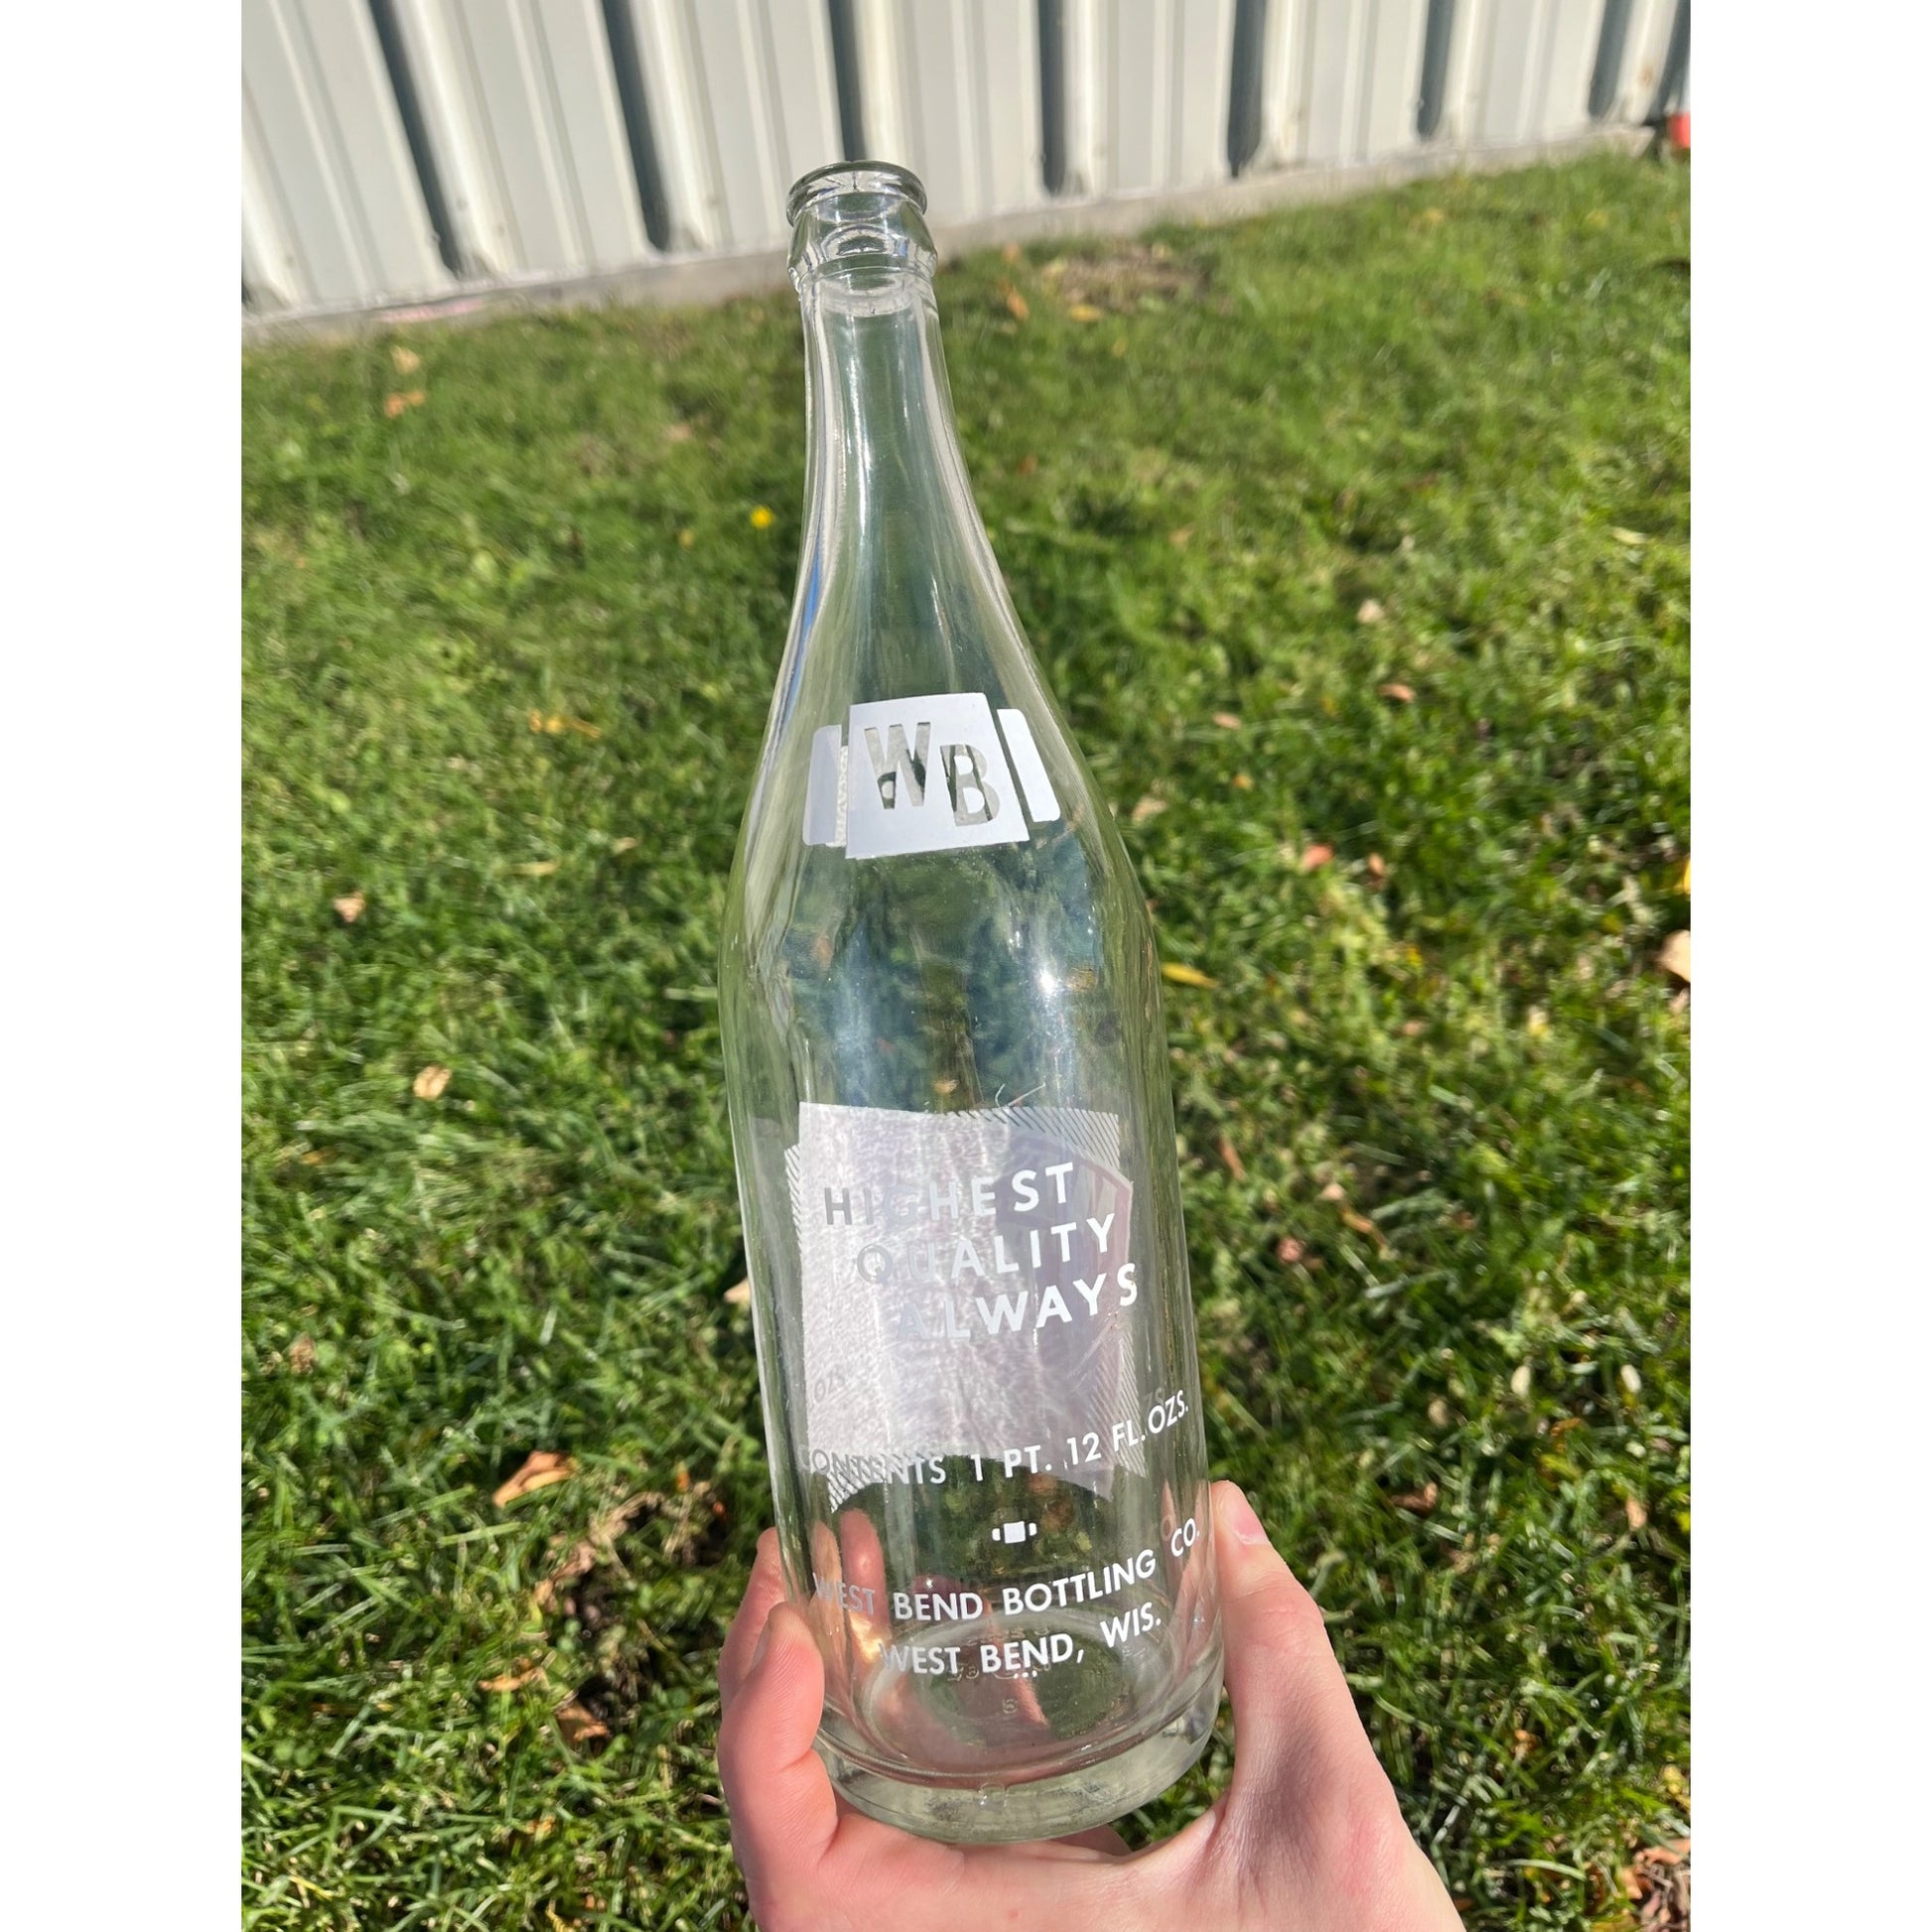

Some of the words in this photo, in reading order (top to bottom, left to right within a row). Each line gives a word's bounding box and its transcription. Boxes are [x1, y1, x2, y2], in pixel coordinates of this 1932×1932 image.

[864, 722, 1000, 826] WB
[824, 1162, 1074, 1226] HIGHEST
[856, 1213, 1115, 1285] QUALITY
[896, 1263, 1137, 1340] ALWAYS
[971, 1452, 983, 1481] 1
[1004, 1445, 1051, 1478] PT.
[1066, 1432, 1102, 1465] 12
[812, 1572, 876, 1616] WEST
[894, 1592, 983, 1621] BEND
[1003, 1549, 1156, 1615] BOTTLING
[1171, 1518, 1200, 1558] CO.
[878, 1642, 961, 1675] WEST
[980, 1633, 1084, 1673] BEND,
[1099, 1601, 1162, 1648] WIS.
